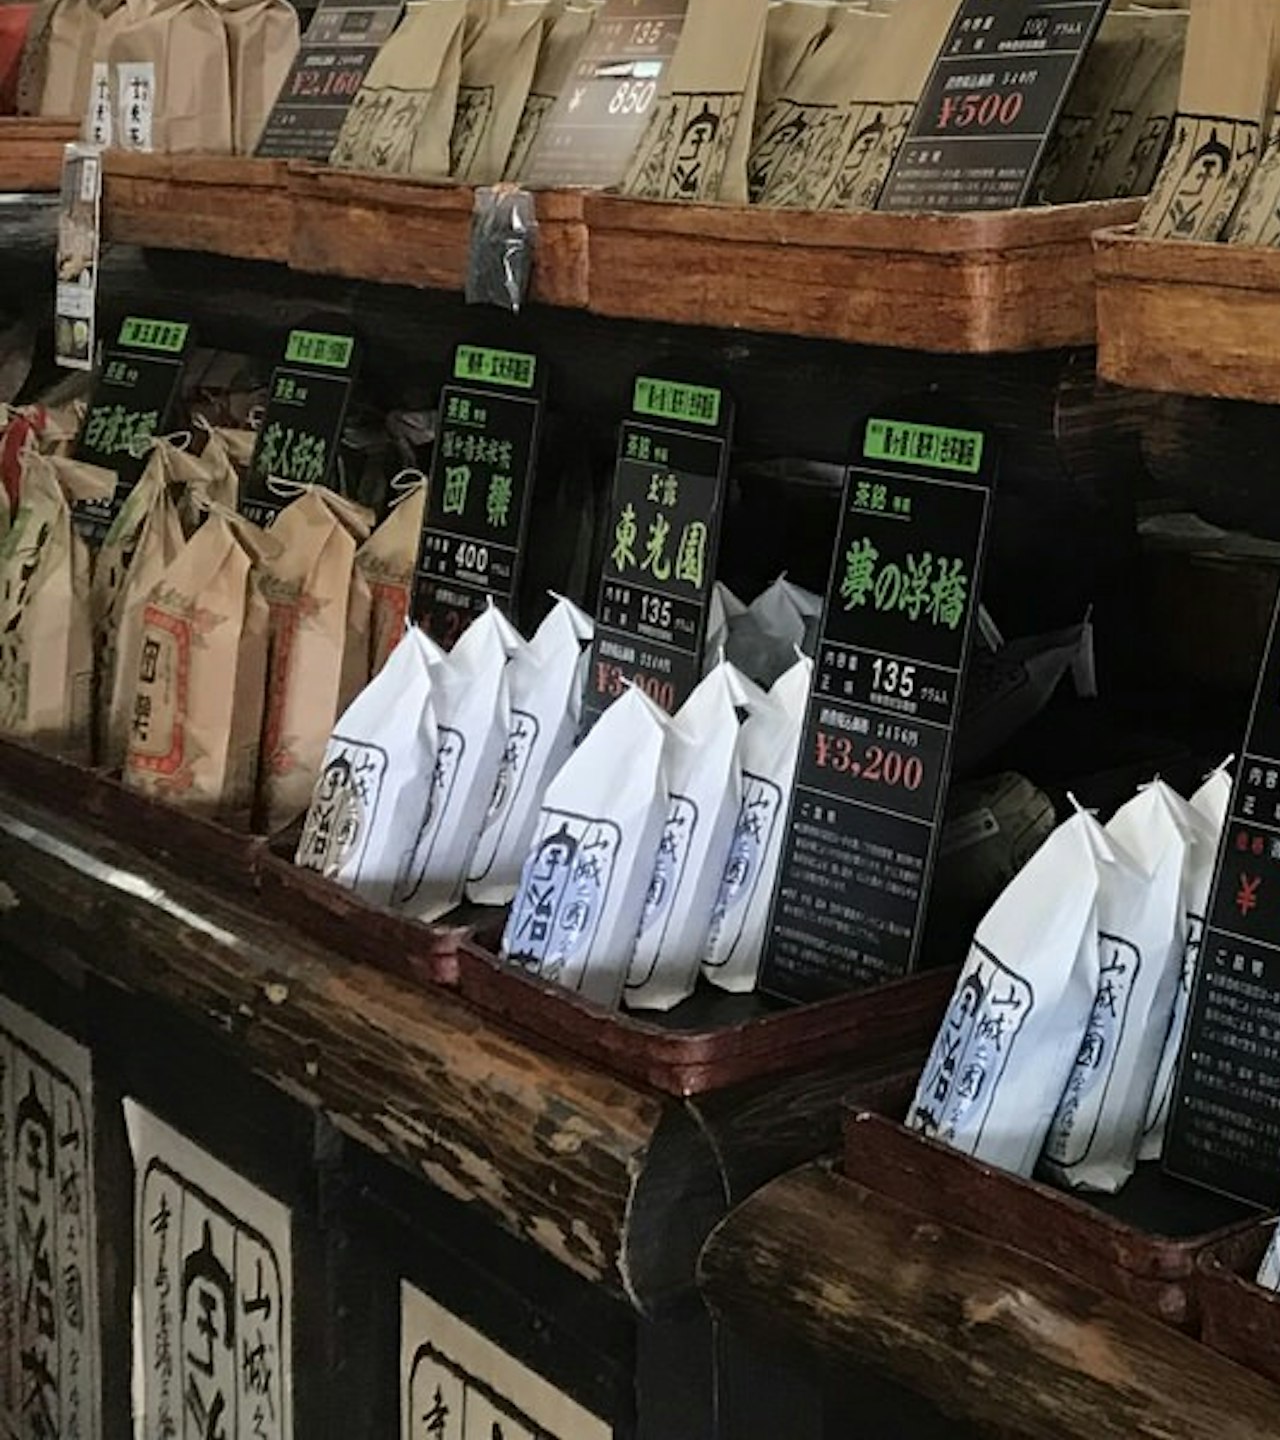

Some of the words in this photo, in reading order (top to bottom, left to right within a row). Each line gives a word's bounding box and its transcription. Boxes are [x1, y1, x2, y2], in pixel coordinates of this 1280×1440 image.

[609, 82, 657, 114] 850
[937, 92, 1024, 129] ¥500
[455, 540, 488, 572] 400
[611, 504, 707, 589] 東光園
[838, 537, 967, 631] 夢の浮橋
[641, 594, 672, 627] 135
[871, 658, 916, 698] 135
[813, 732, 923, 791] ¥3,200
[1236, 875, 1263, 917] ¥
